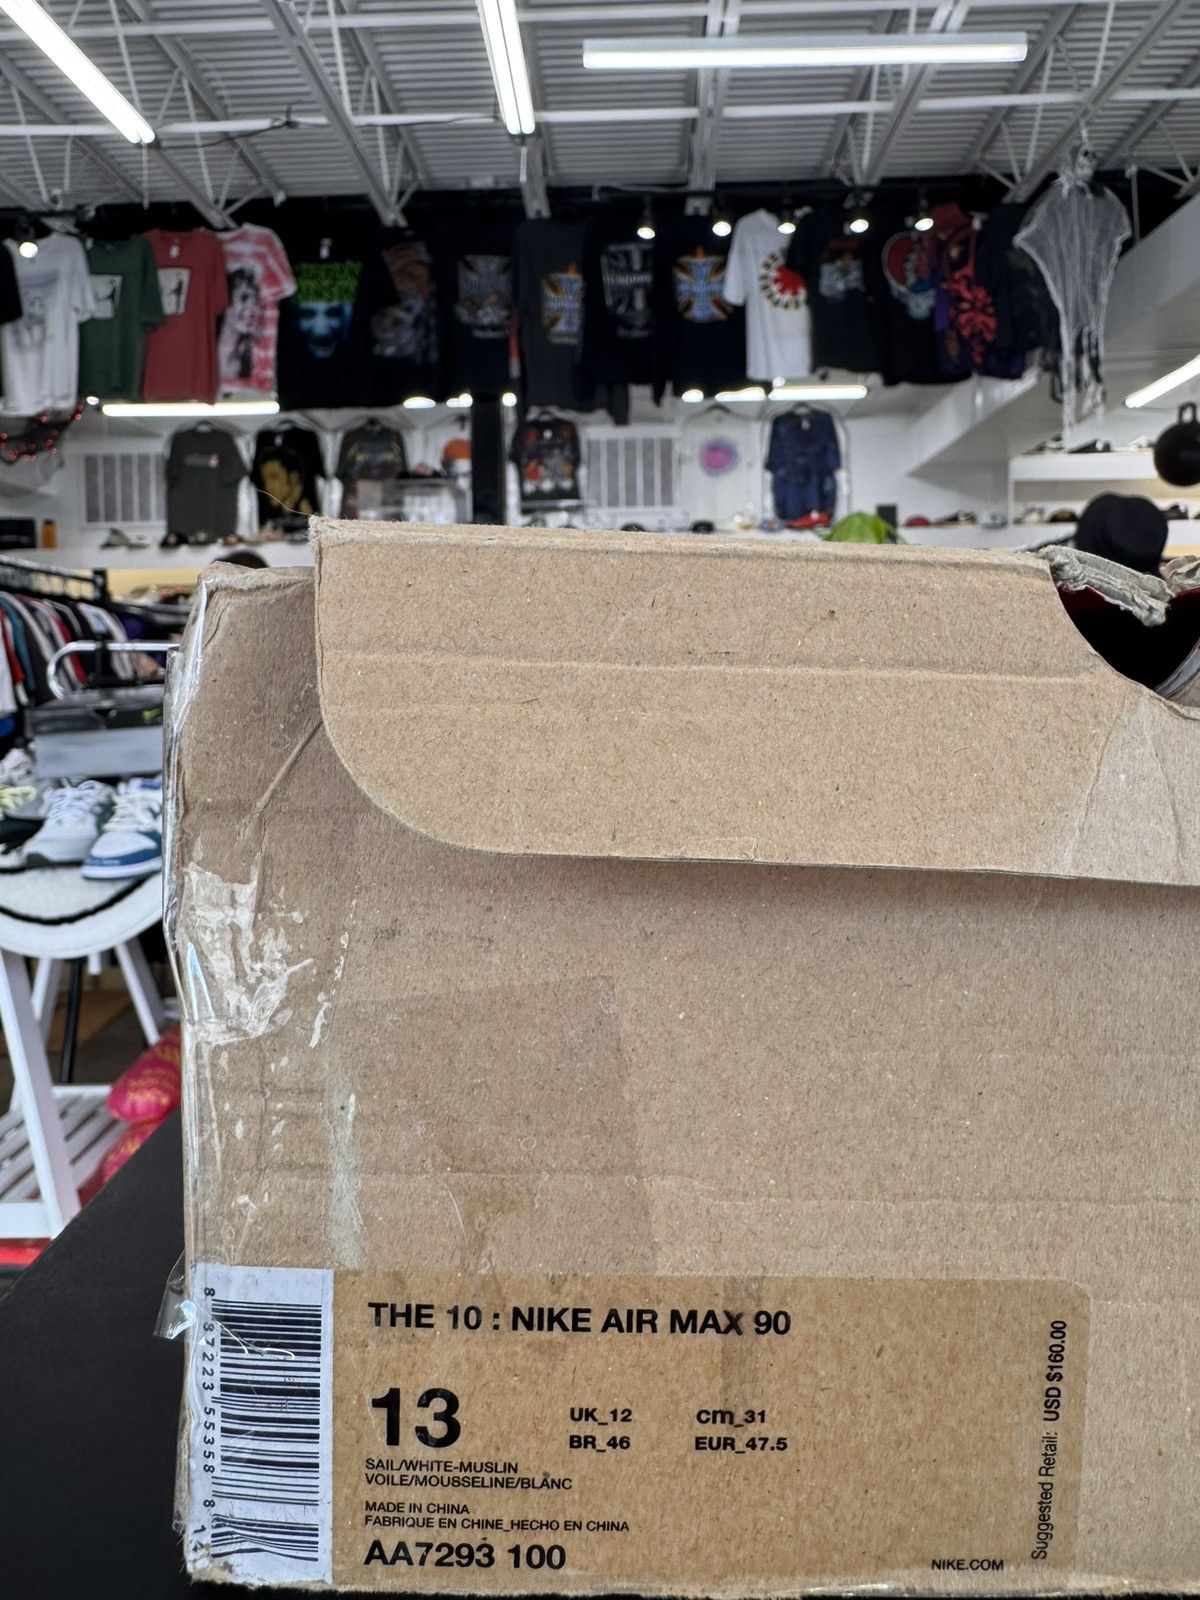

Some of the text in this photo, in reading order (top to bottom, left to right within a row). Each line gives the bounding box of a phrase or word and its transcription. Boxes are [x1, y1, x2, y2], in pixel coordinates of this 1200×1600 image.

[368, 1302, 791, 1336] THE 10 : NIKE AIR MAX 90
[371, 1387, 462, 1449] 13
[569, 1406, 633, 1426] UK_12
[696, 1408, 766, 1428] cm_31
[203, 1406, 216, 1474] 55358
[568, 1434, 631, 1453] BR_46
[694, 1435, 788, 1455] EUR_47.5
[1030, 1319, 1068, 1561] Suggested Retail: USD $160.00
[365, 1457, 519, 1474] SAIL/WHITE-MUSLIN
[365, 1473, 573, 1490] VOILE/MOUSSELINE/BLANC
[365, 1500, 470, 1516] MADE IN CHINA
[364, 1514, 630, 1533] FABRIQUE EN CHINE_HECHO EN CHINA
[364, 1539, 566, 1570] AA7293 100
[931, 1558, 1005, 1571] NIKE.COM
